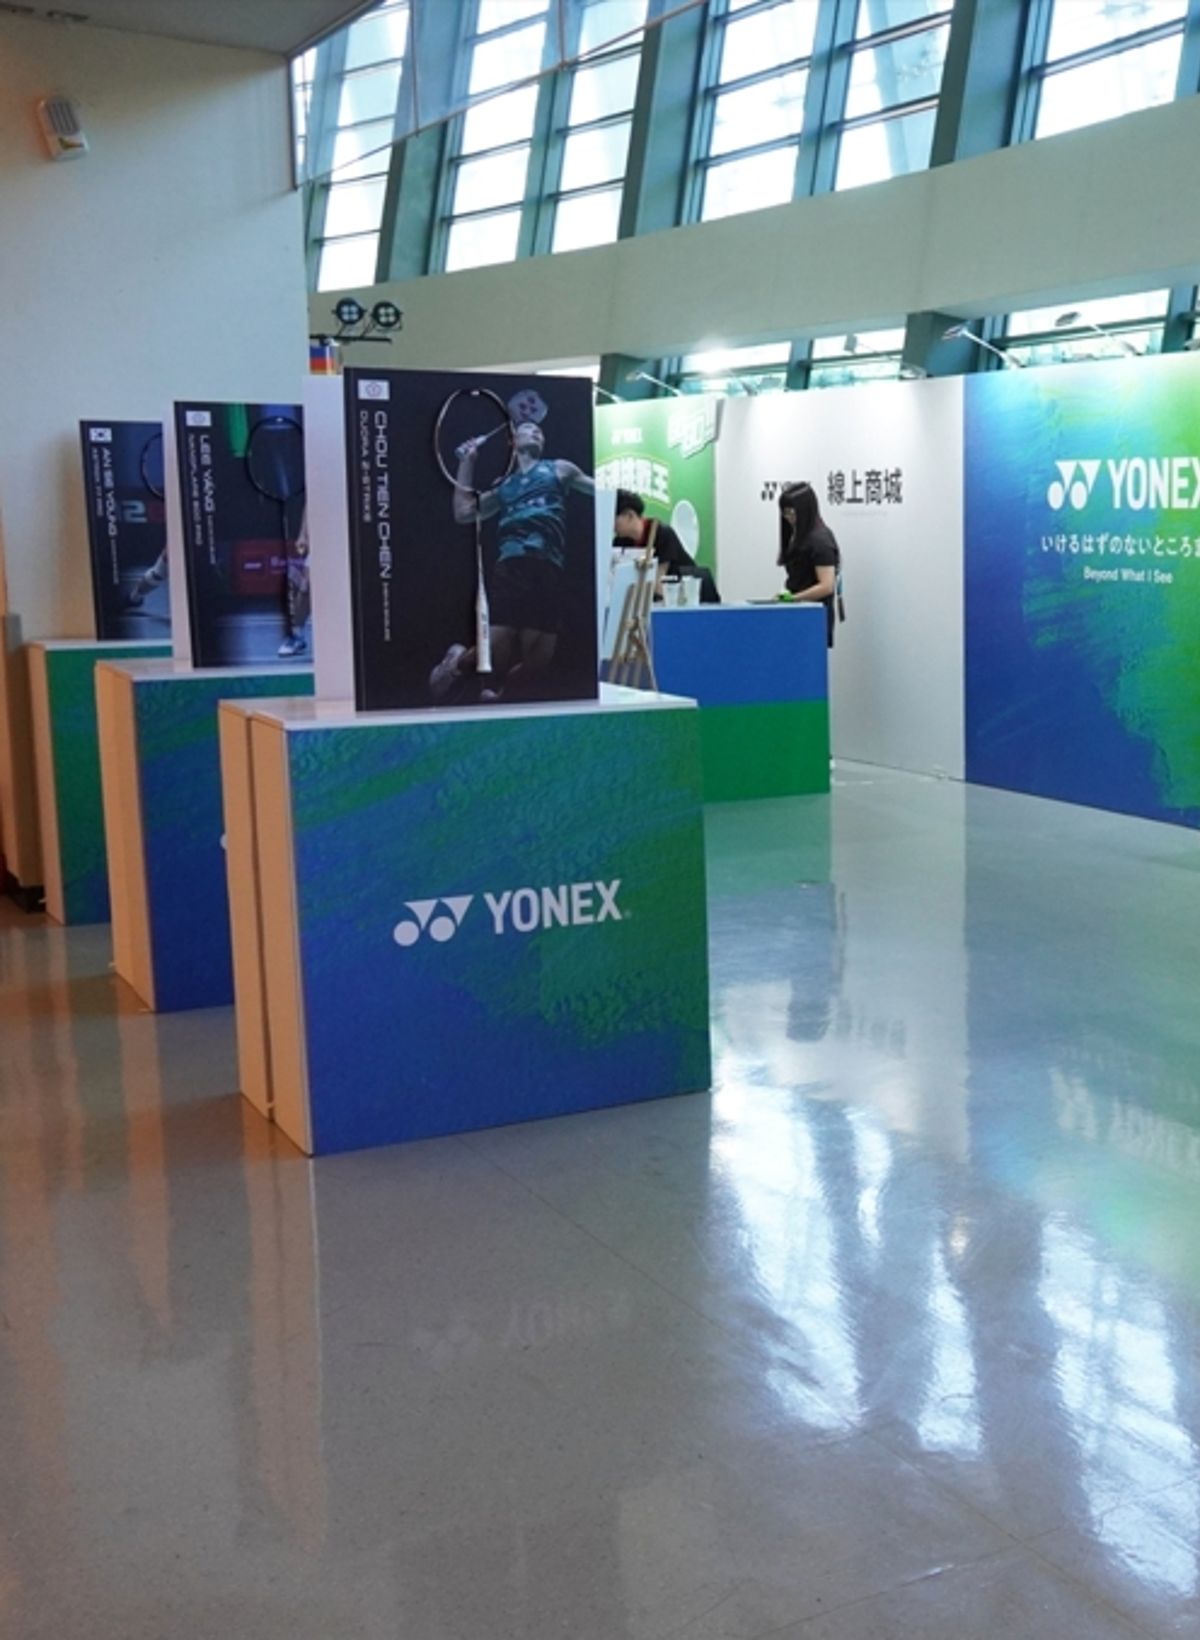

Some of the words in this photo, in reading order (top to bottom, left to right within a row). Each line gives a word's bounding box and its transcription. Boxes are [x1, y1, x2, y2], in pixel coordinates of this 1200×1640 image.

[374, 410, 388, 468] CHOU
[376, 472, 390, 519] TIEN
[827, 467, 903, 505] 線上商城
[378, 522, 392, 579] CHEN
[1083, 566, 1118, 584] Beyond
[1121, 568, 1145, 582] What
[1153, 569, 1173, 584] See
[483, 879, 622, 935] YONEX
